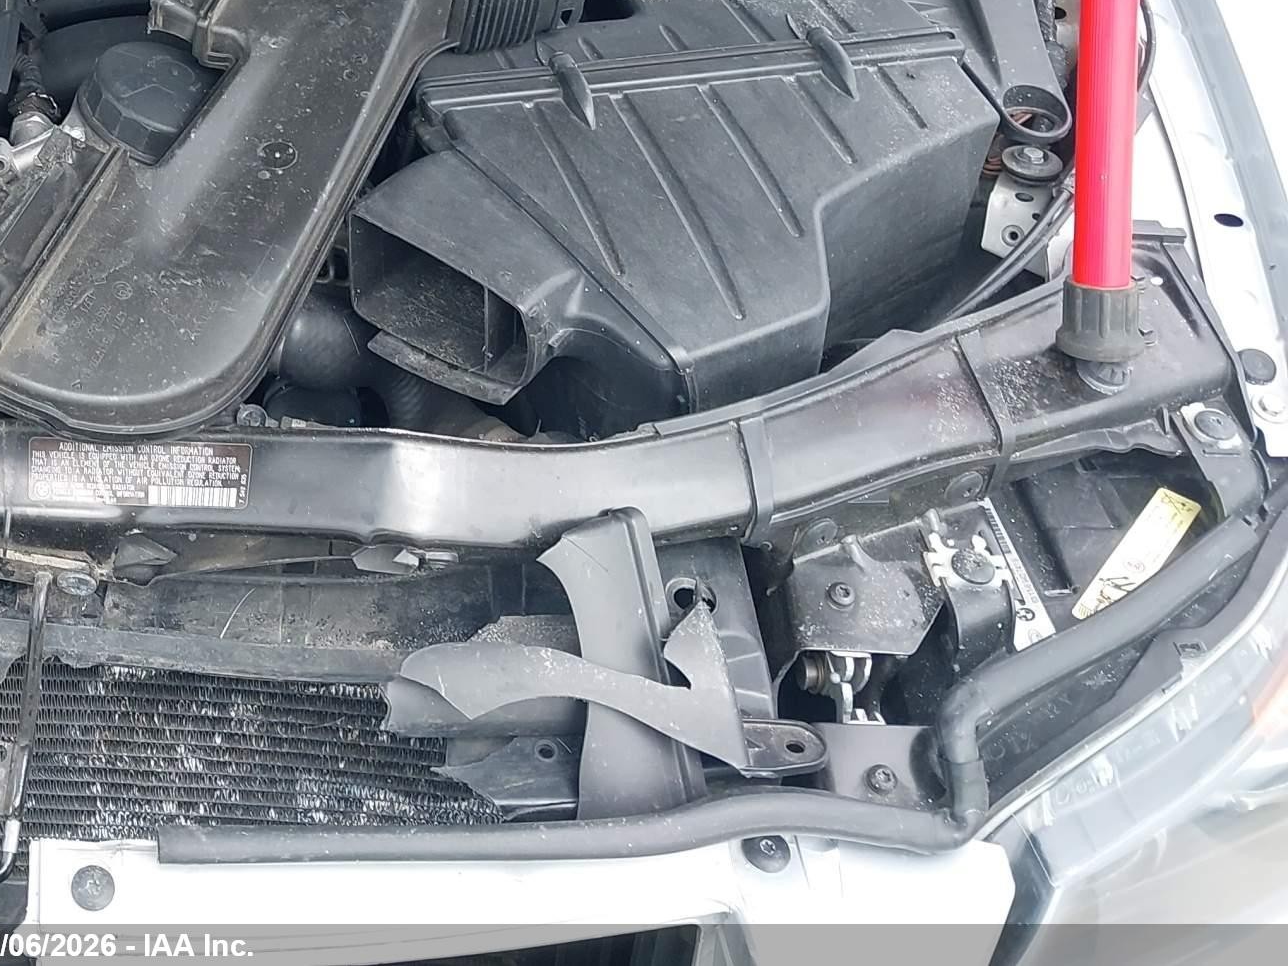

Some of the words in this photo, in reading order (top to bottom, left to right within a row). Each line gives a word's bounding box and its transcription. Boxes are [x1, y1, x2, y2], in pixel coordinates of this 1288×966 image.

[59, 442, 98, 452] ADDITIONAL
[102, 444, 134, 453] EMISSION
[137, 444, 166, 454] CONTROL
[170, 446, 214, 456] INFORMATION
[32, 450, 46, 458] THIS
[49, 451, 75, 460] VEHICLE
[88, 452, 119, 461] EQUIPPED
[120, 453, 136, 461] WITH
[151, 454, 170, 462] OZONE
[173, 455, 206, 464] REDUCTION
[208, 456, 237, 465] RADIATOR
[32, 458, 47, 466] THAT
[72, 459, 100, 468] ELEMENT
[114, 460, 125, 468] THE
[129, 461, 156, 470] VEHICLE
[158, 462, 187, 471] EMISSION
[189, 464, 214, 472] CONTROL
[83, 467, 114, 475] RADIATOR
[117, 468, 144, 477] WITHOUT
[146, 469, 185, 478] EQUIVALENT
[187, 471, 206, 479] OZONE
[208, 472, 239, 481] REDUCTION
[89, 475, 122, 484] VIOLATION
[136, 477, 148, 485] AIR
[151, 478, 184, 486] POLLUTION
